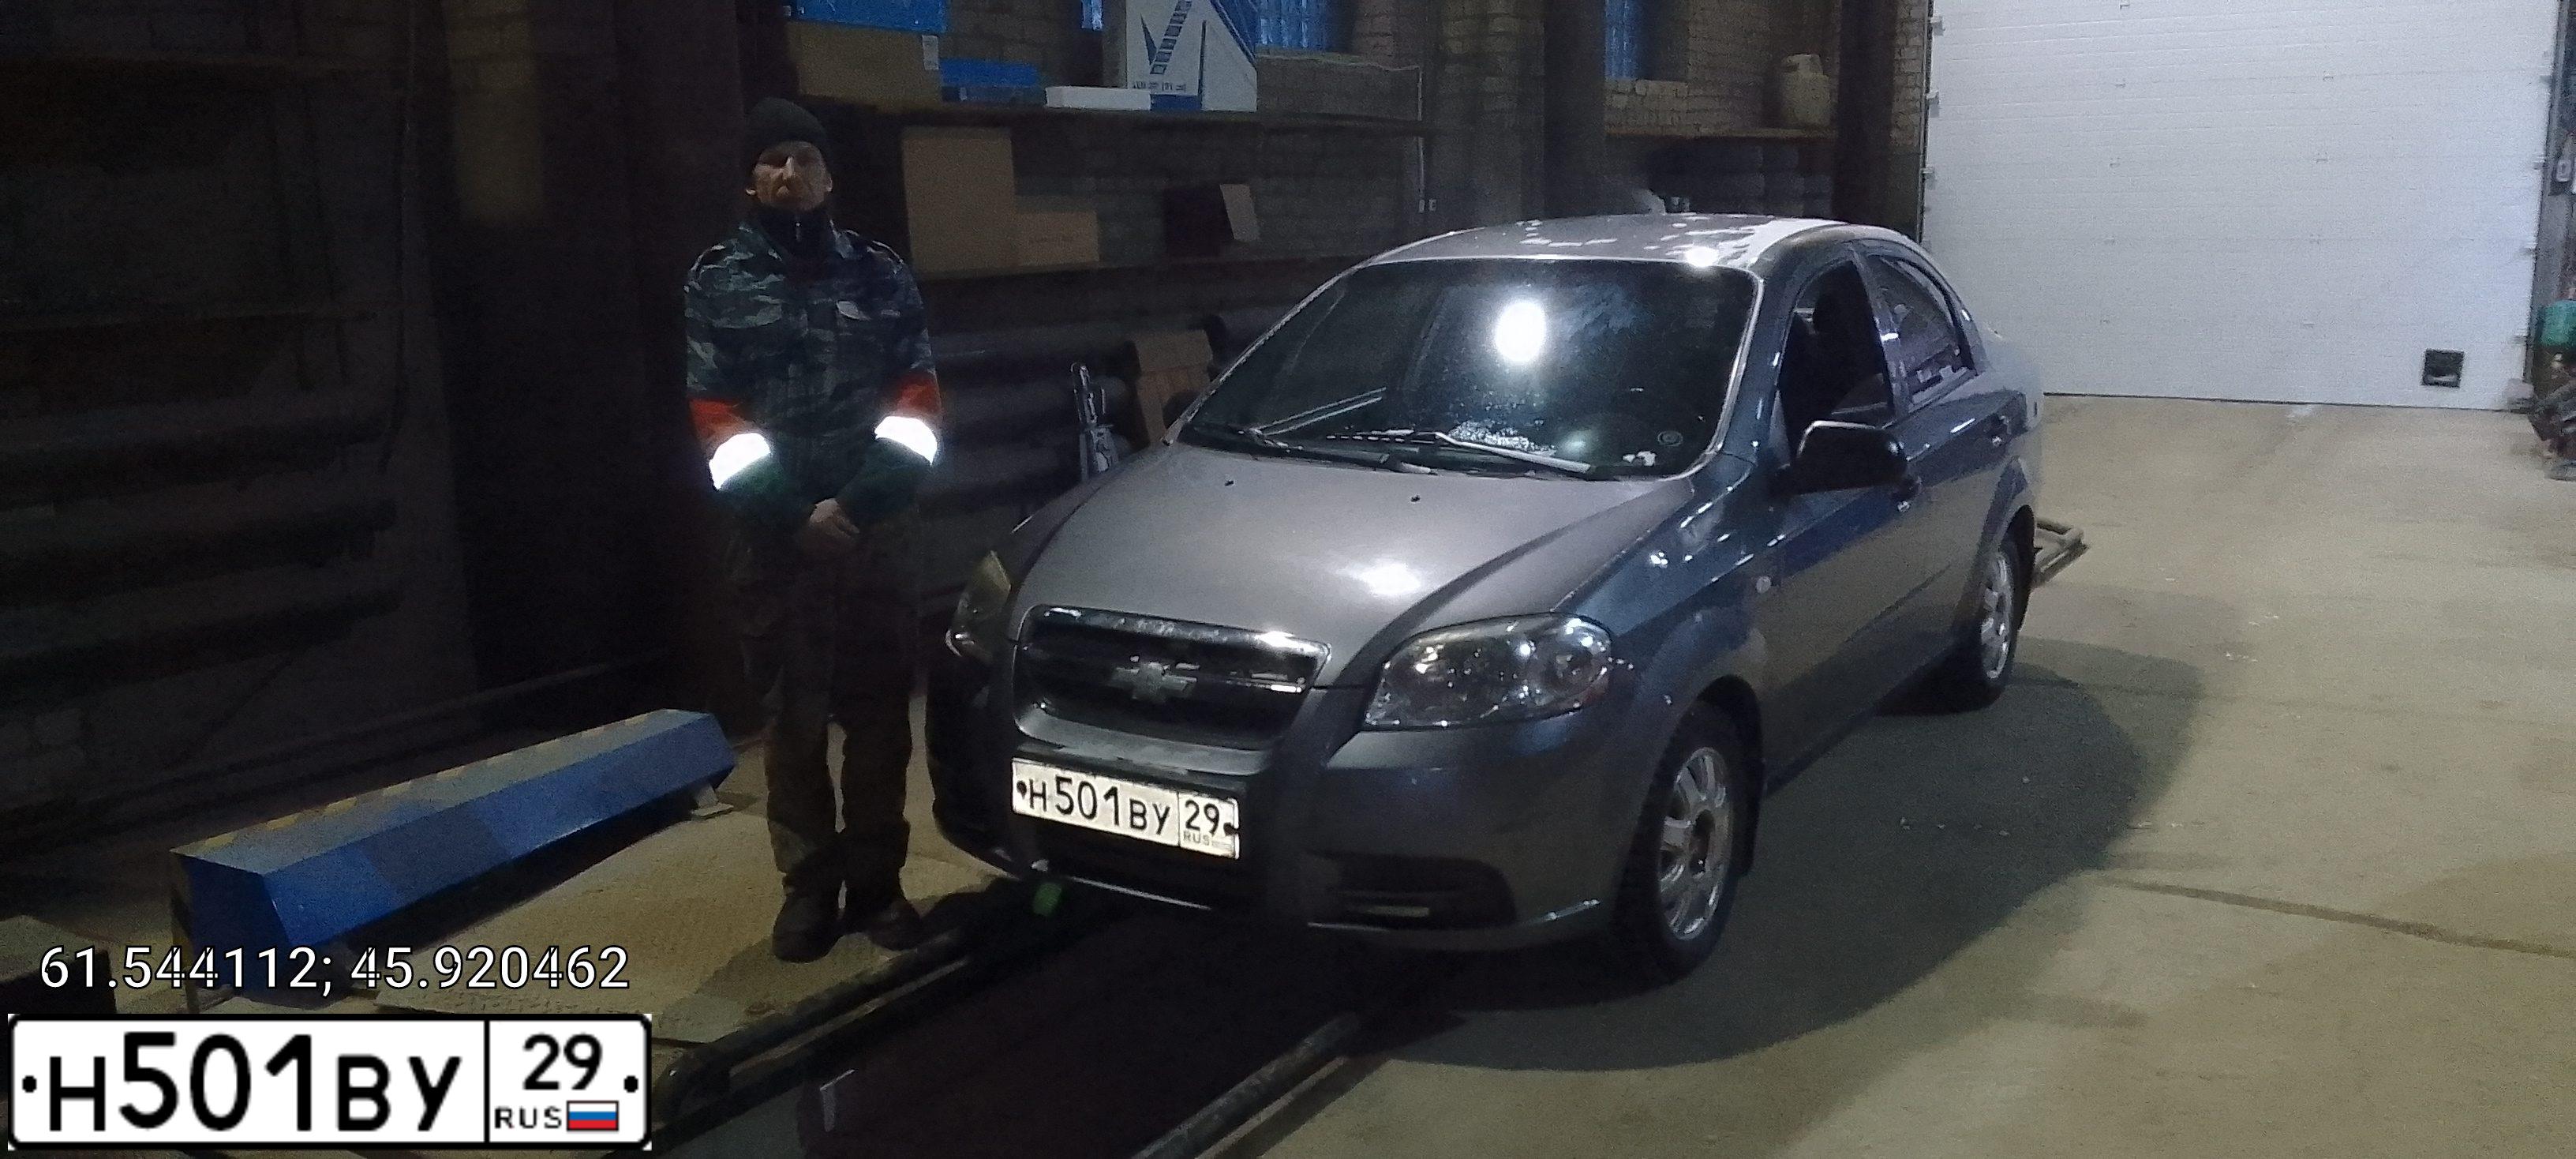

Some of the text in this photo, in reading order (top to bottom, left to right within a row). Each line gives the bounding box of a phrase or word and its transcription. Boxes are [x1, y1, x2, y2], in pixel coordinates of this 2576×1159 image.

[1029, 776, 1220, 837] Н501ВУ 29
[1183, 830, 1211, 846] RUS
